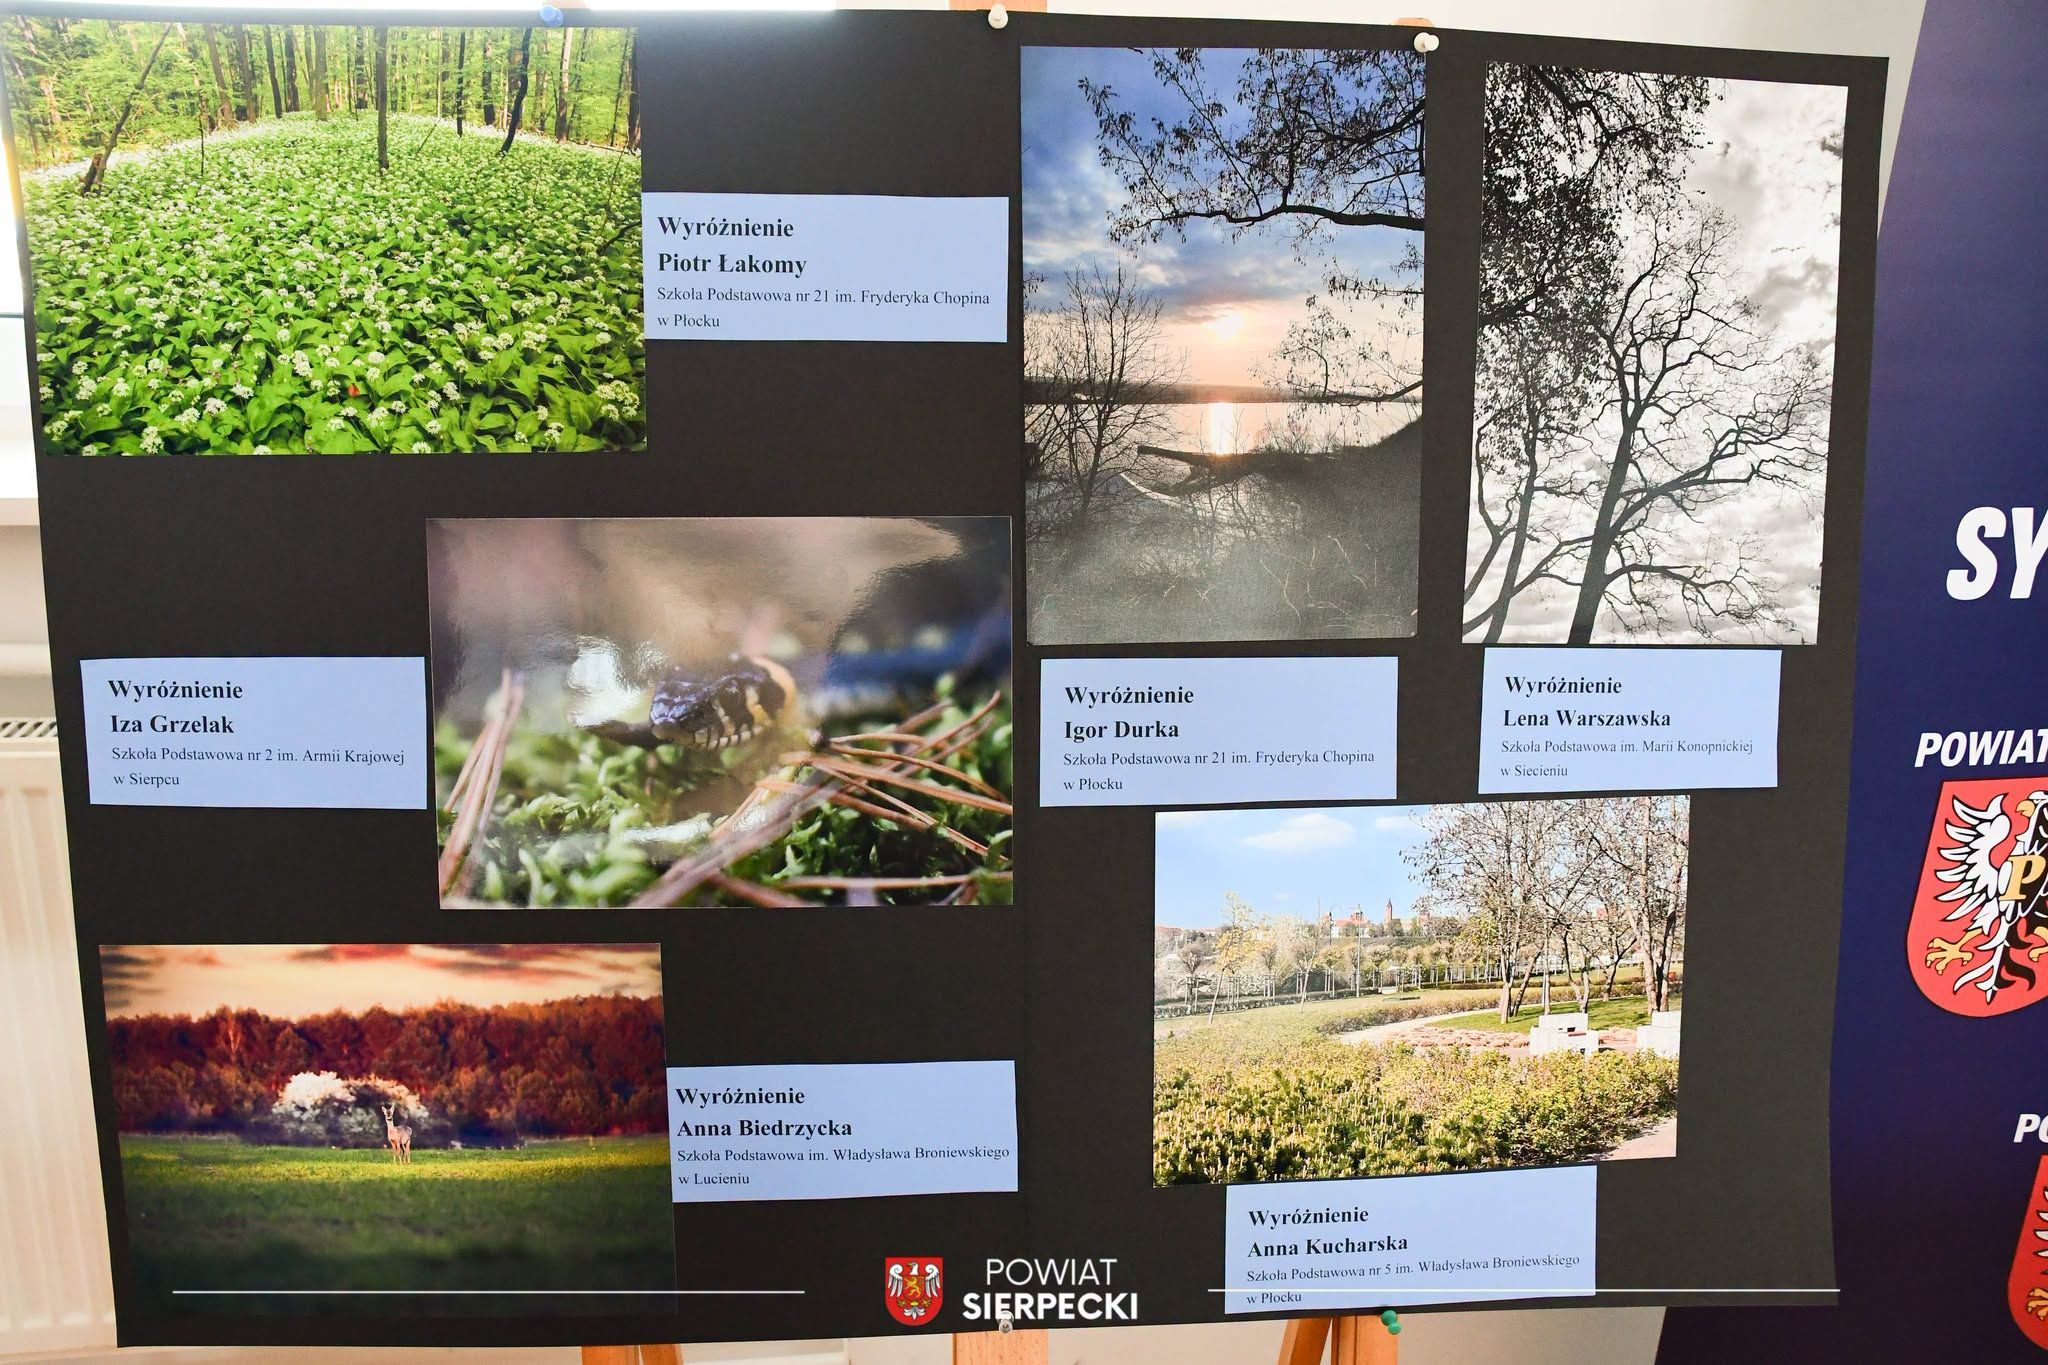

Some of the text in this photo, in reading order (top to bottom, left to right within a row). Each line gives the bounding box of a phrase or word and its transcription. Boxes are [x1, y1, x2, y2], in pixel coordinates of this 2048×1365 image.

[657, 216, 794, 241] Wyróżnienie
[658, 252, 807, 279] Piotr Łakomy
[657, 286, 990, 308] Szkoła Podstawowa nr 21 im. Fryderyka Chopina
[657, 313, 720, 328] w Płocku
[107, 679, 243, 703] Wyróżnienie
[1064, 685, 1194, 709] Wyróżnienie
[1504, 676, 1622, 698] Wyróżnienie
[110, 714, 235, 734] Iza Grzelak
[1503, 709, 1671, 727] Lena Warszawska
[1065, 720, 1179, 744] Igor Durka
[111, 747, 404, 766] Szkoła Podstawowa nr 2 im. Armii Krajowej
[1063, 749, 1375, 767] Szkoła Podstawowa nr 21 im. Fryderyka Chopina
[1501, 739, 1753, 755] Szkoła Podstawowa im. Marii Konopnickiej
[1914, 729, 2048, 768] POWIAT
[113, 772, 180, 789] w Sierpcu
[1500, 764, 1568, 777] w Siecieniu
[1063, 777, 1123, 791] w Płocku
[675, 1087, 805, 1110] Wyróżnienie
[676, 1119, 852, 1141] Anna Biedrzycka
[677, 1145, 1010, 1163] Szkoła Podstawowa im. Władysława Broniewskiego
[678, 1172, 750, 1185] w Lucieniu
[1248, 1206, 1369, 1231] Wyróżnienie
[1247, 1235, 1408, 1258] Anna Kucharska
[1246, 1254, 1580, 1282] Szkoła Podstawowa nr 5 im. Władysława Broniewskiego
[1246, 1291, 1302, 1304] w Płocku
